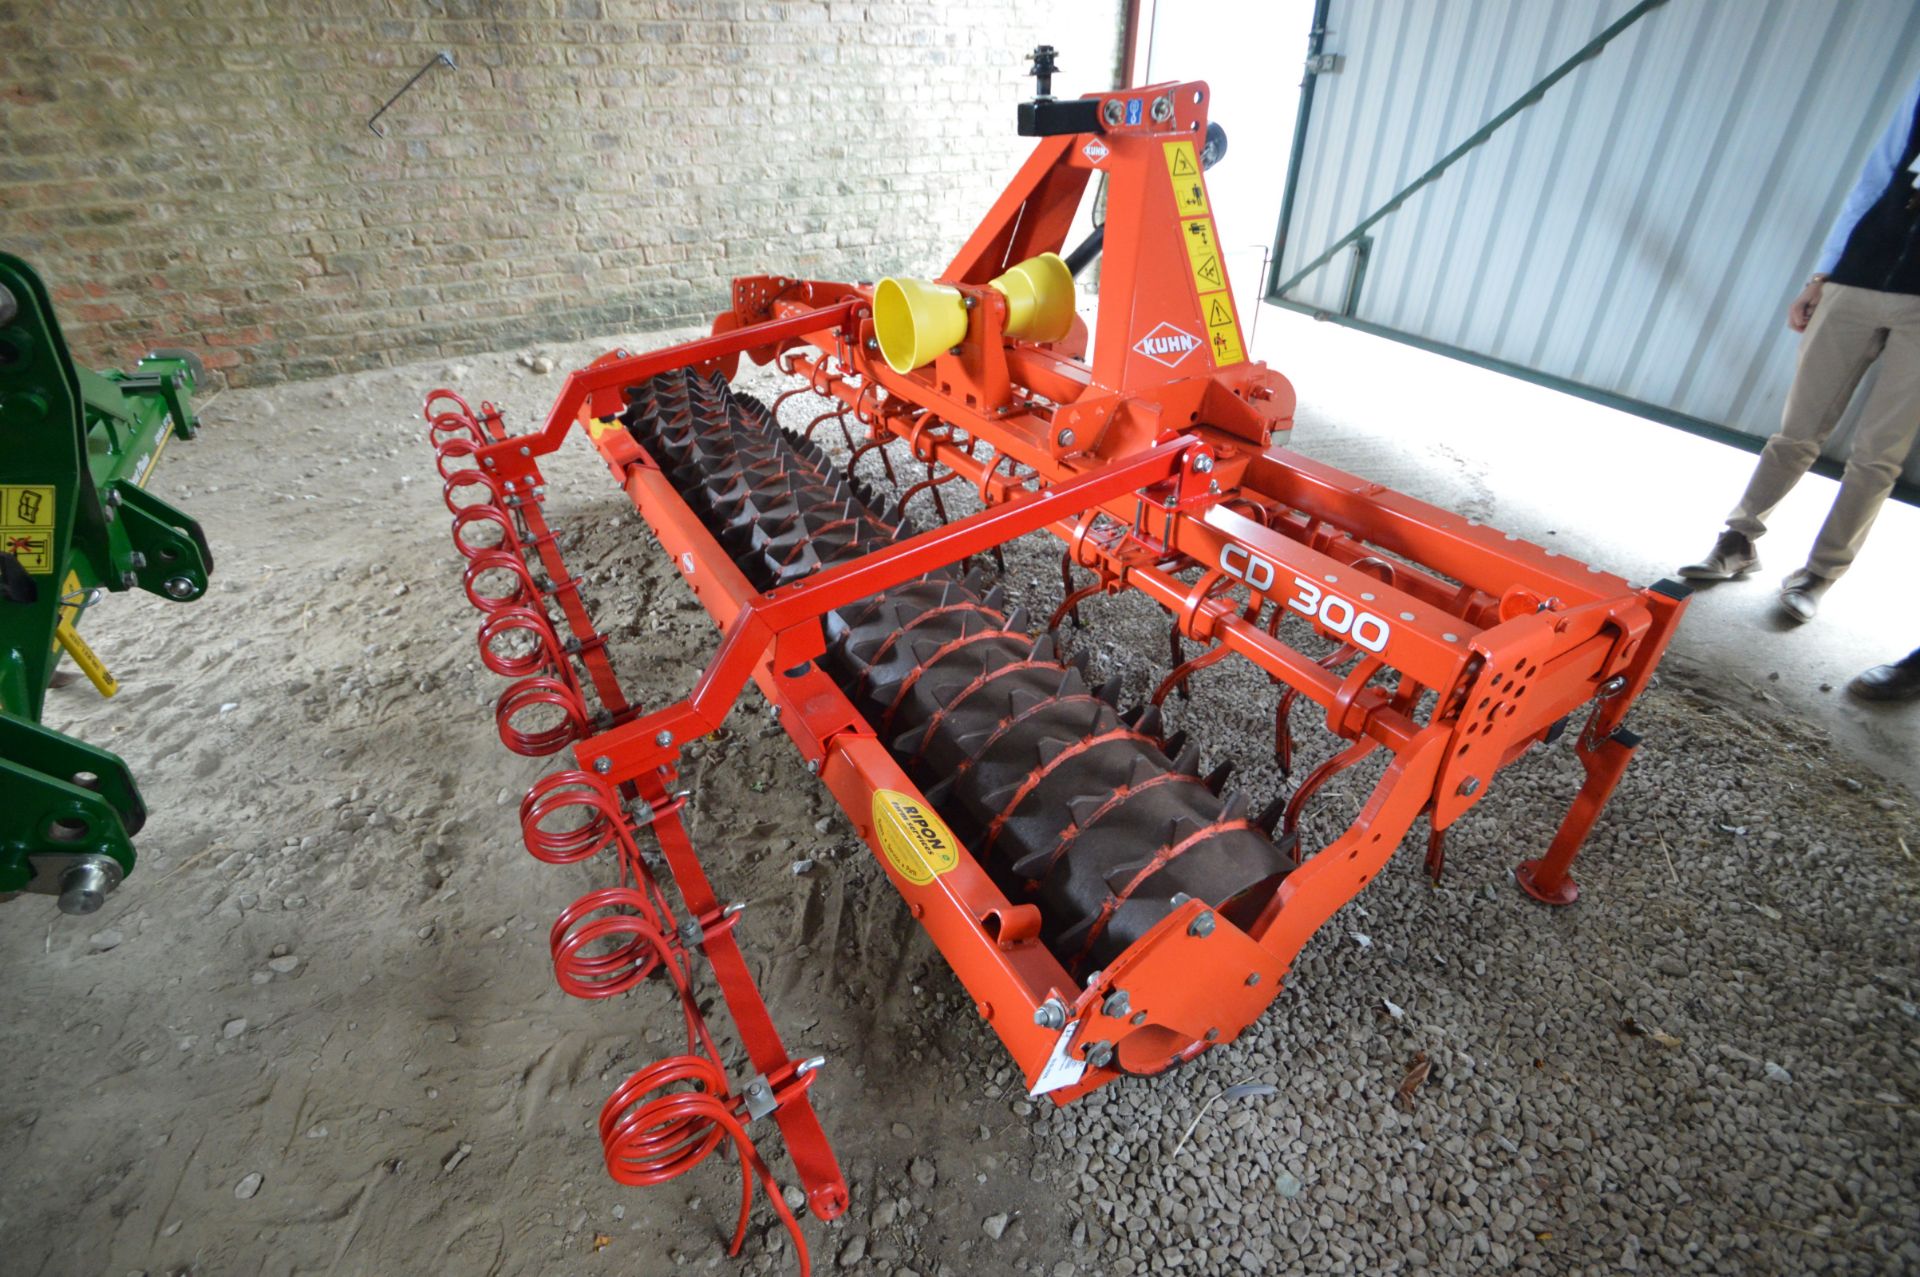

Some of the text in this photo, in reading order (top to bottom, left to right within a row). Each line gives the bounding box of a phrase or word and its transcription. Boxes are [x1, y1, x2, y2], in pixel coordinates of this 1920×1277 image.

[1084, 144, 1107, 157] KUHN
[1142, 334, 1193, 355] KUHN
[1219, 542, 1391, 653] CD 300
[902, 805, 946, 851] RIPON
[907, 821, 934, 856] services
